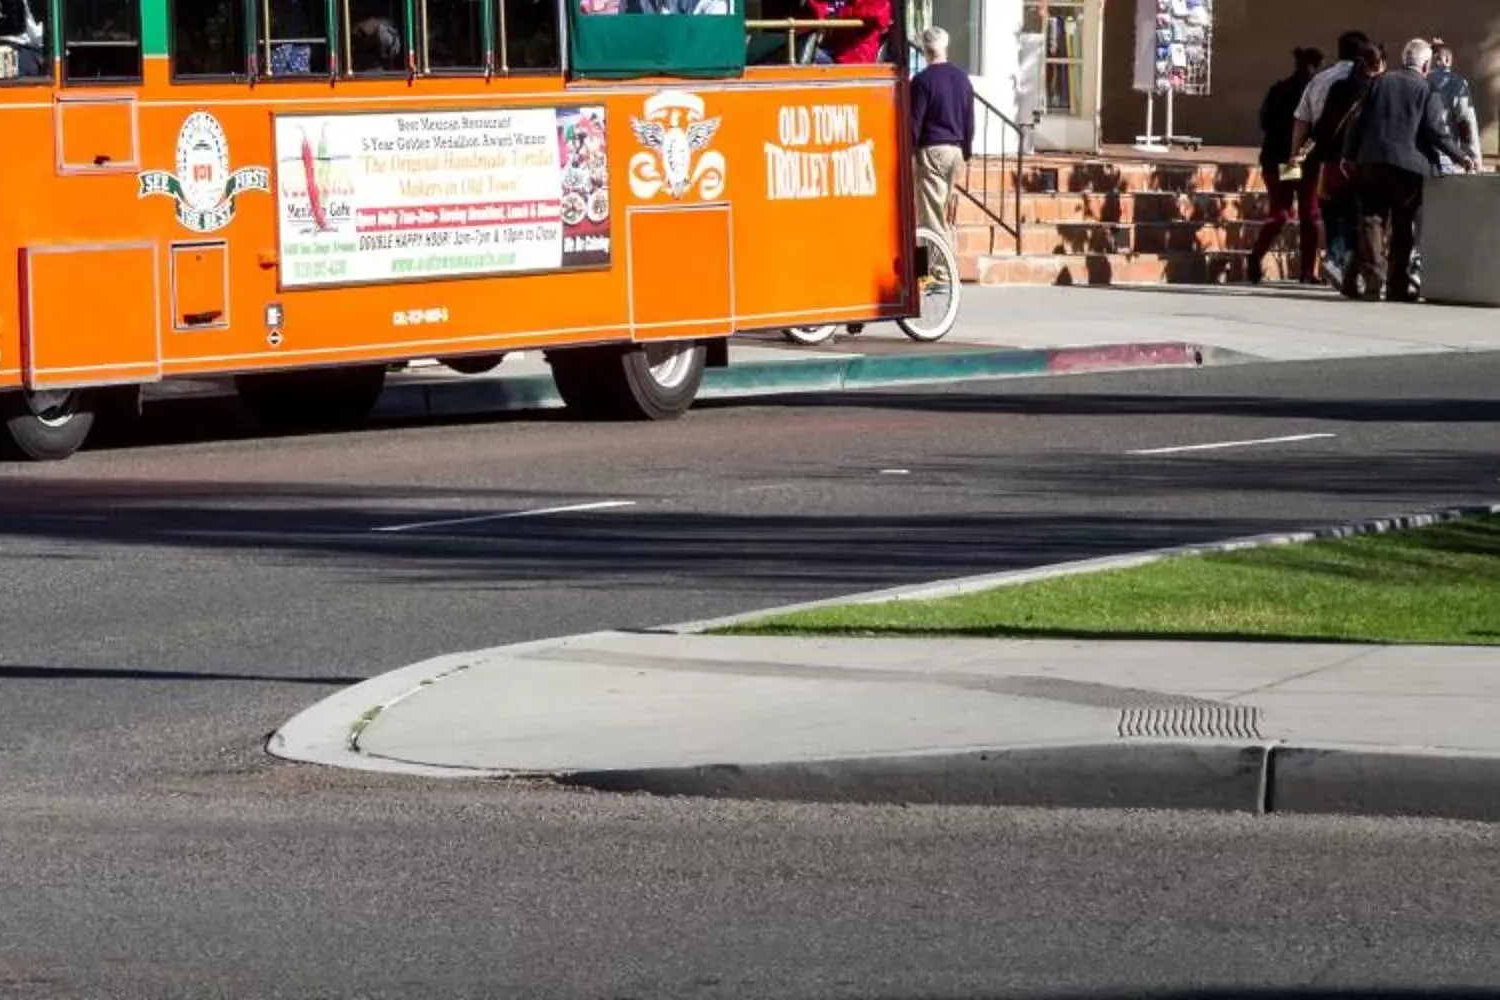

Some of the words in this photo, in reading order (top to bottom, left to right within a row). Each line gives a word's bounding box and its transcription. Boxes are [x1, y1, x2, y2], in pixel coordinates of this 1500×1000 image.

[779, 105, 809, 145] OLD
[812, 104, 859, 146] TOWN
[764, 141, 829, 200] TROLLEY
[831, 138, 877, 196] TOURS
